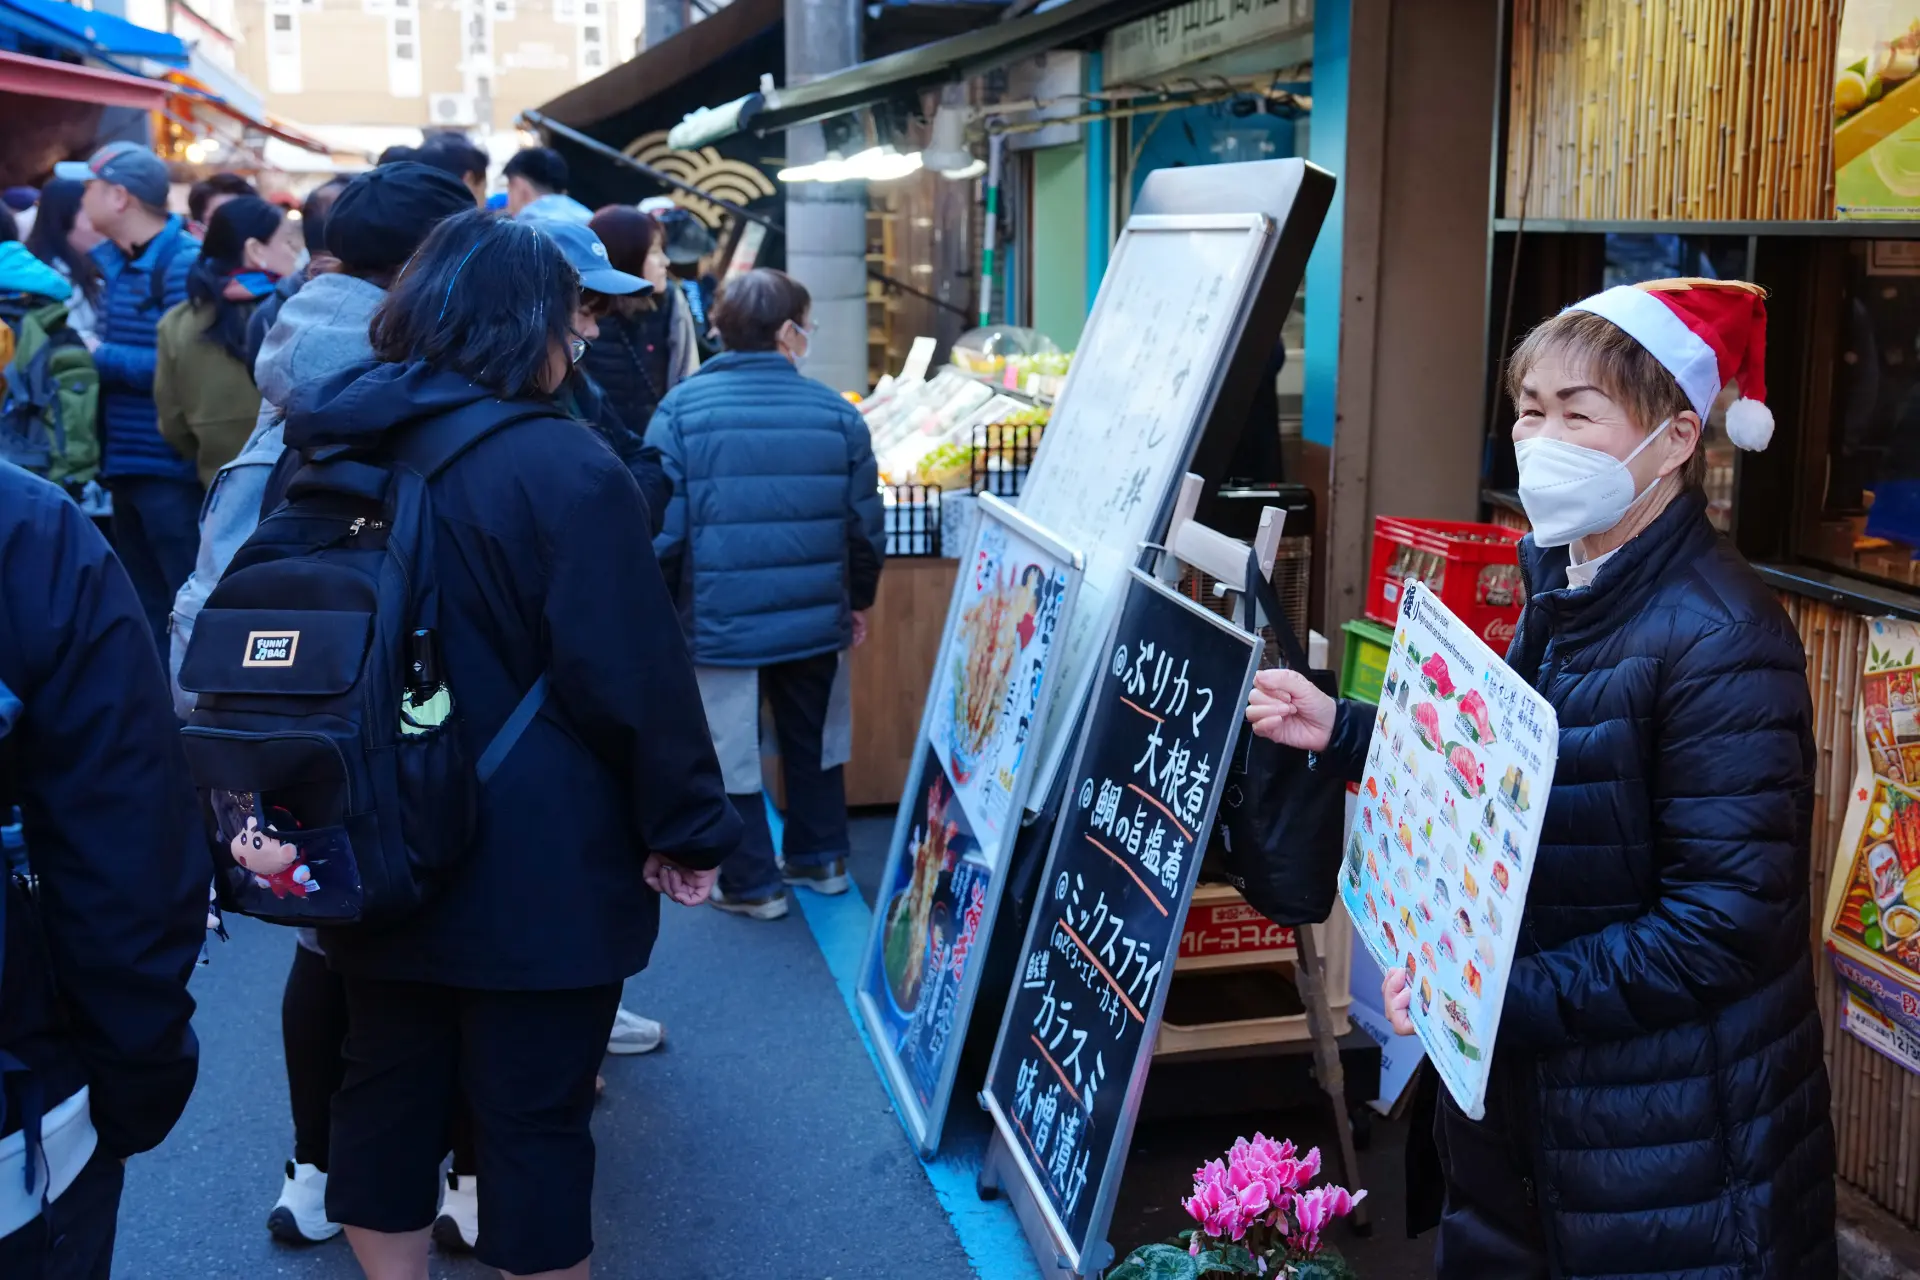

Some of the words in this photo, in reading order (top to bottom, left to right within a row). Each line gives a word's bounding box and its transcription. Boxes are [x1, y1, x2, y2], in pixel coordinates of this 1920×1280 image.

[257, 638, 289, 649] FUNNY
[267, 649, 286, 659] BAG
[1122, 639, 1213, 738] ぶりカマ
[1133, 721, 1211, 832] 大根煮
[1090, 778, 1184, 899] 鯛の旨塩煮
[1066, 873, 1162, 1008] ミックスフライ
[1033, 979, 1106, 1114] カラスミ
[1015, 1057, 1090, 1215] 味噌漬け
